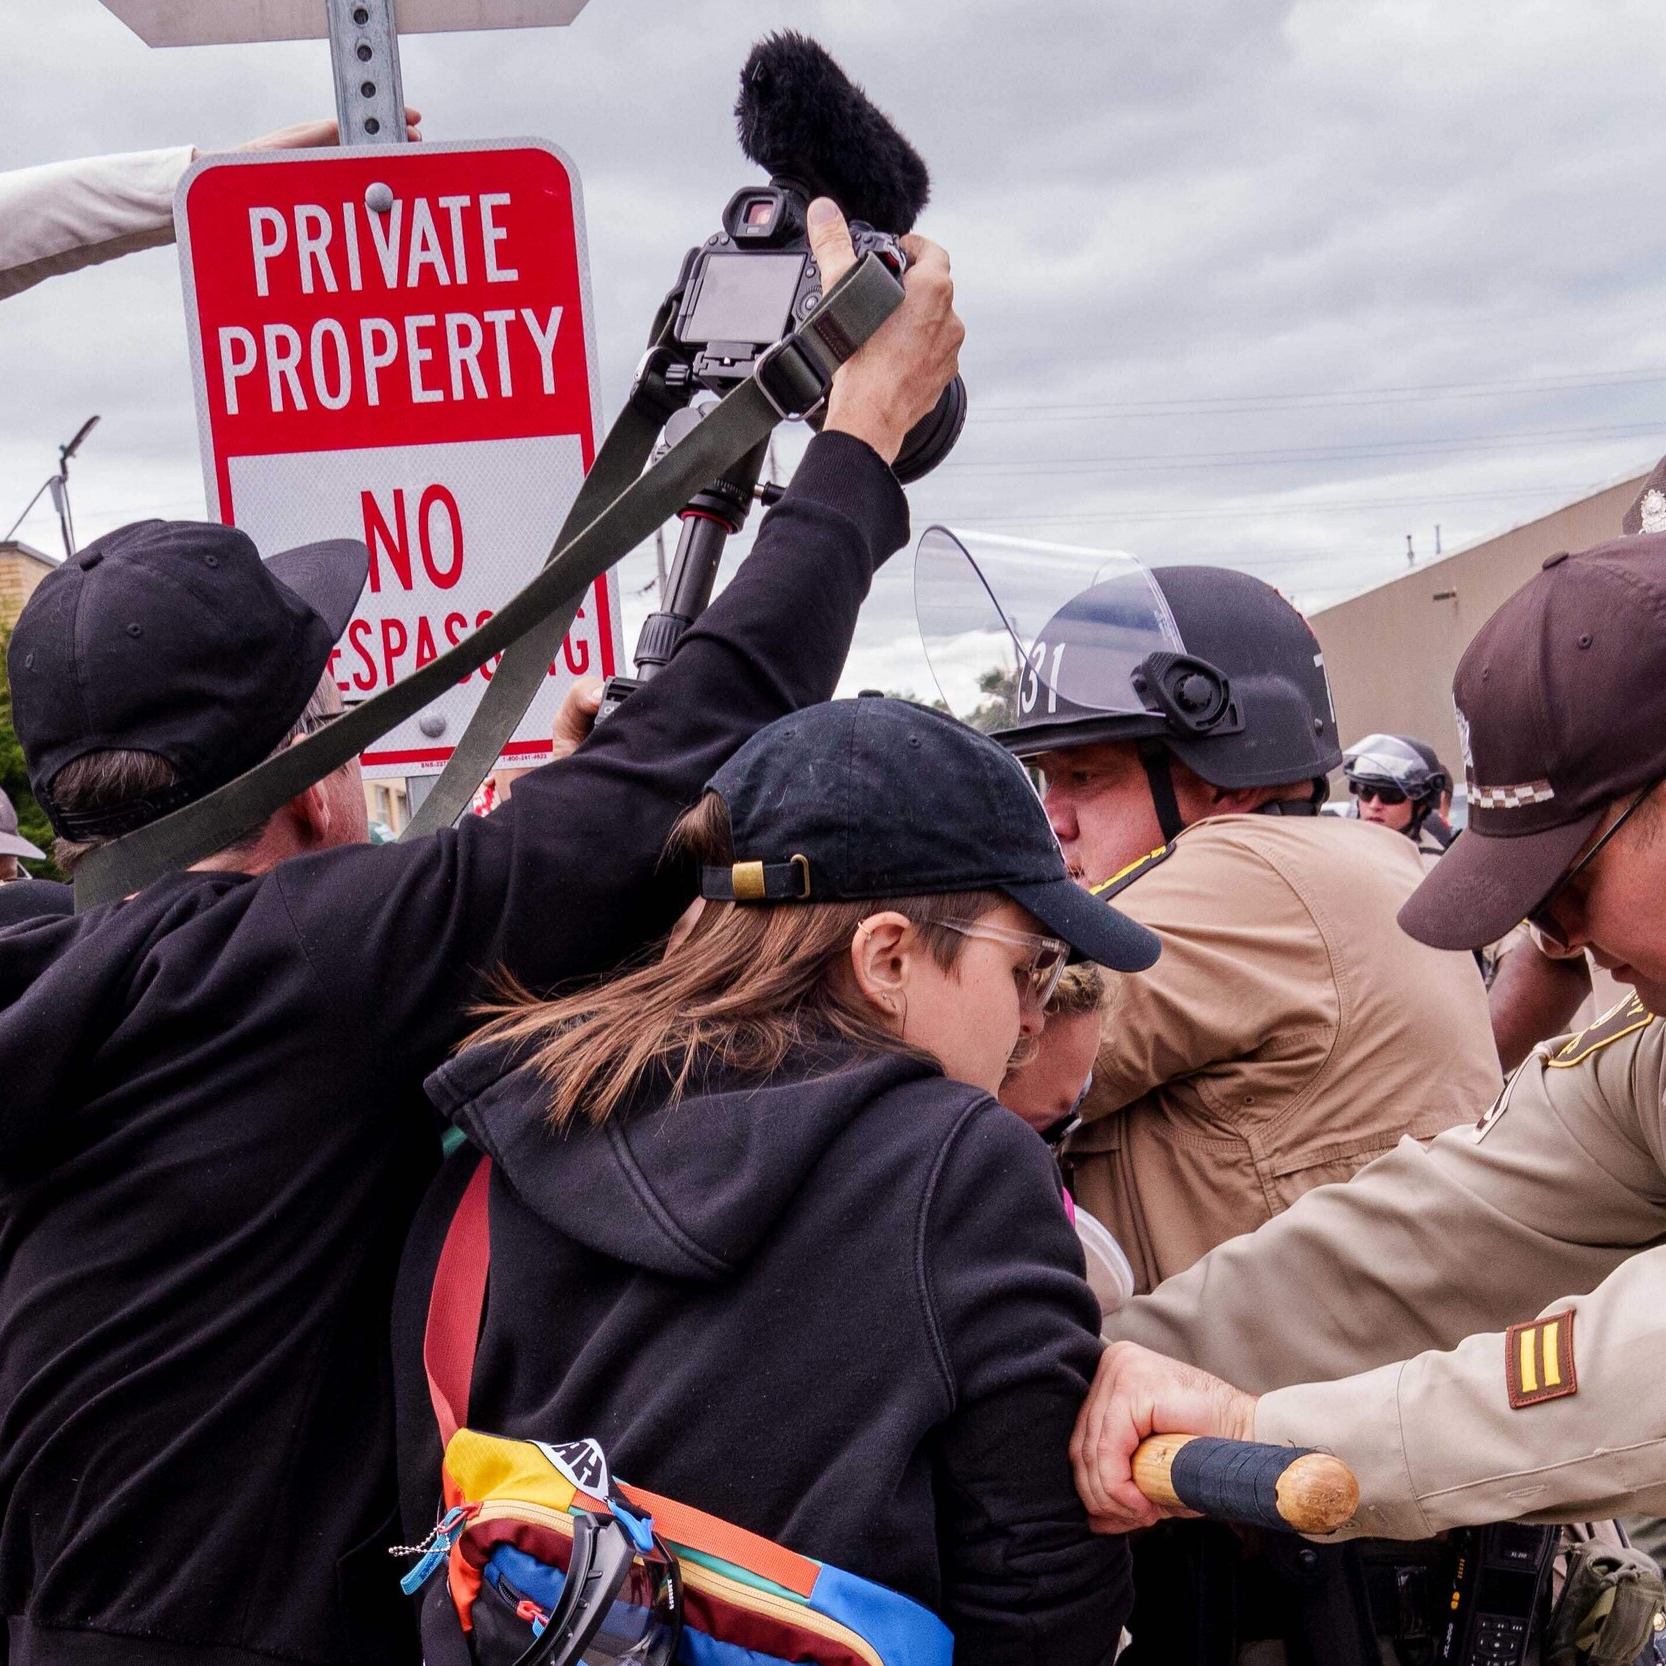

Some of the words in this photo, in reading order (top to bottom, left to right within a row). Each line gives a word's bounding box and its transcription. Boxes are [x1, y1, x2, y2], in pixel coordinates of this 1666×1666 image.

[247, 193, 520, 298] PRIVATE
[217, 306, 564, 415] PROPERTY
[361, 483, 464, 593] NO
[1017, 641, 1066, 718] 31
